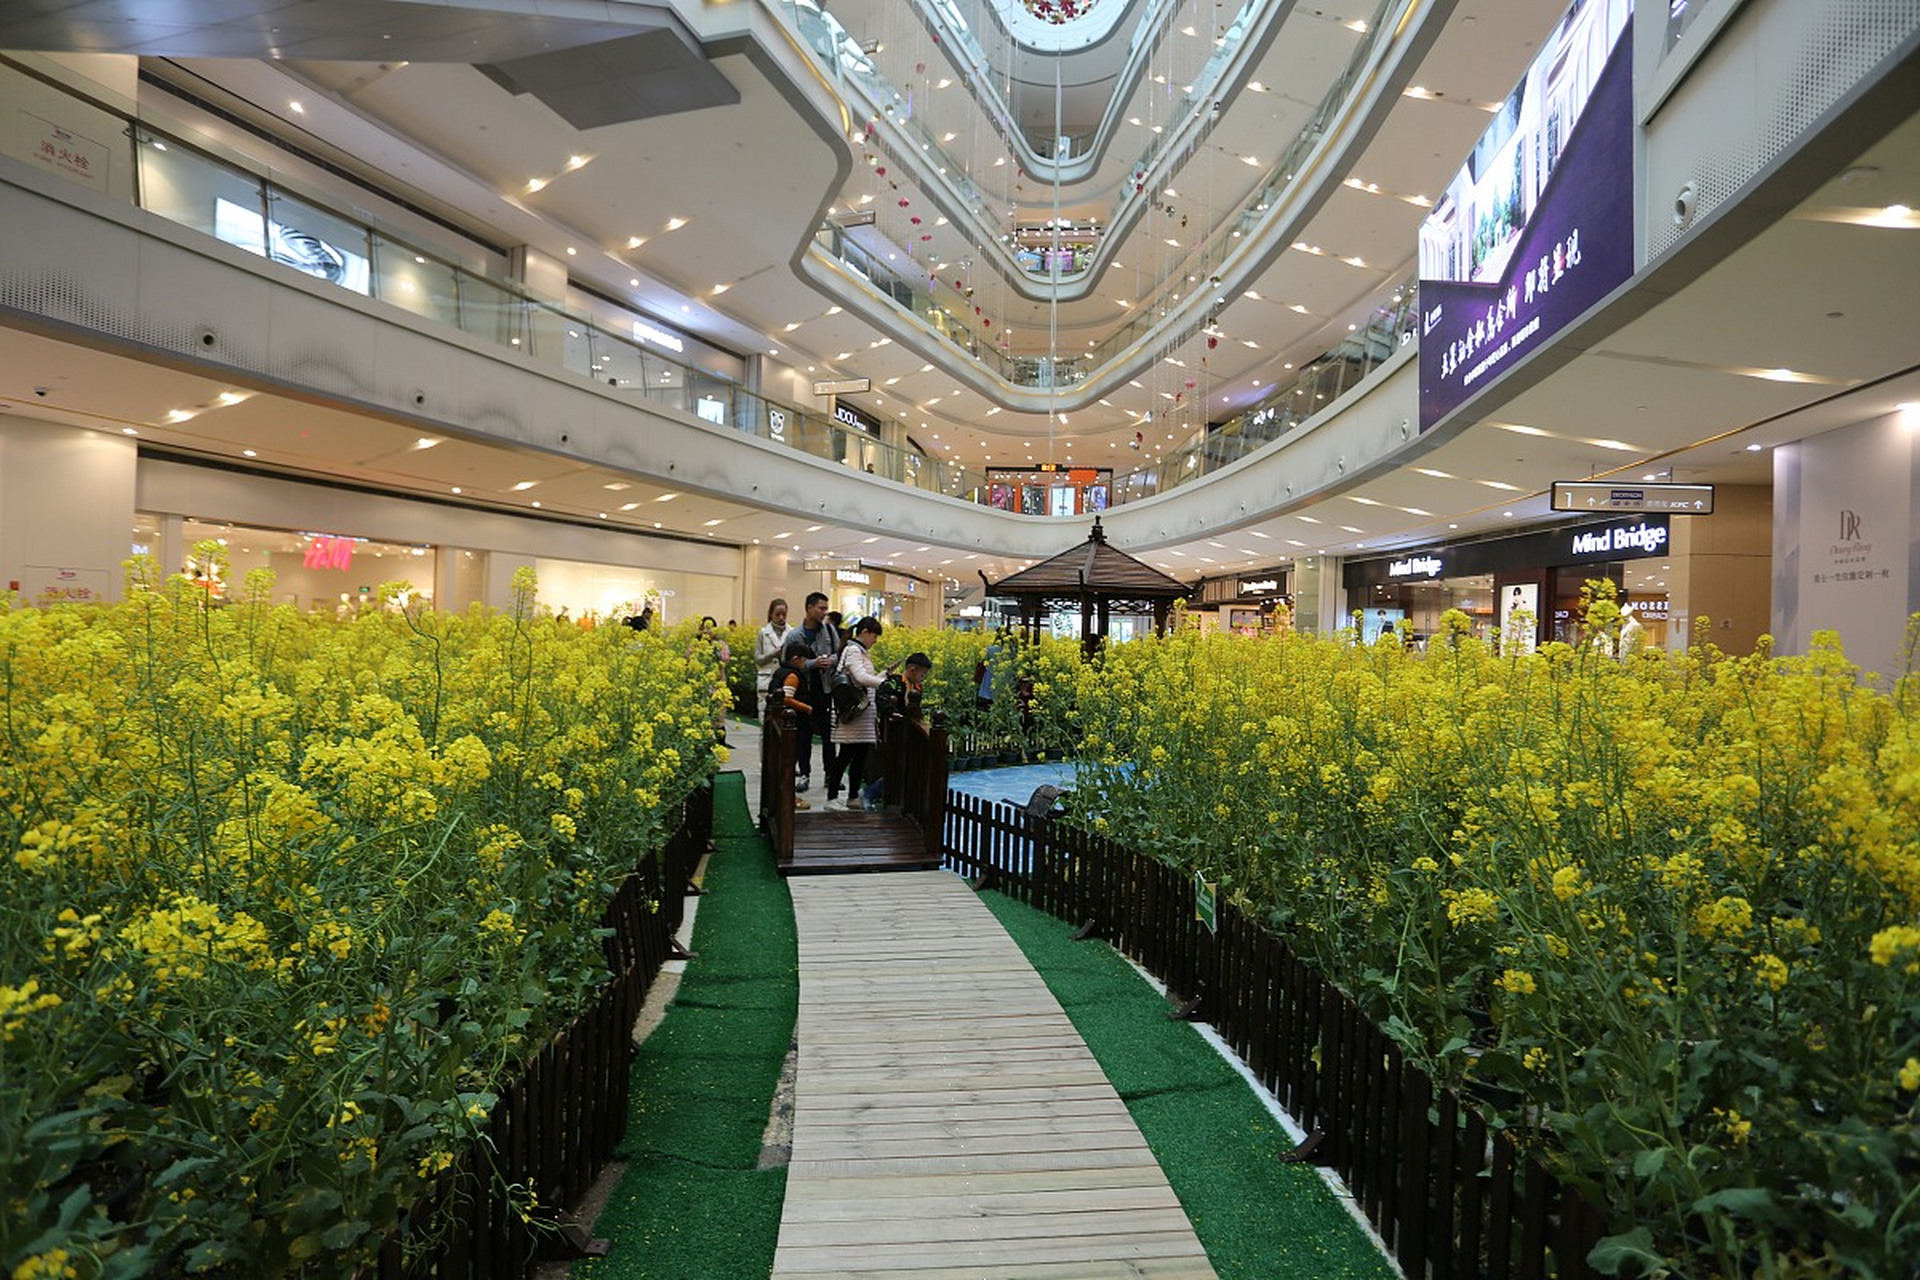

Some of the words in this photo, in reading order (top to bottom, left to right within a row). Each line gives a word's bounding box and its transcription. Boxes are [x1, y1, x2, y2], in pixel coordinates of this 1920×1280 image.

[40, 140, 90, 170] 消火栓
[1572, 529, 1610, 554] Mind
[1614, 523, 1666, 551] Bridge
[1389, 558, 1411, 576] Mind
[1412, 556, 1442, 576] Bridge
